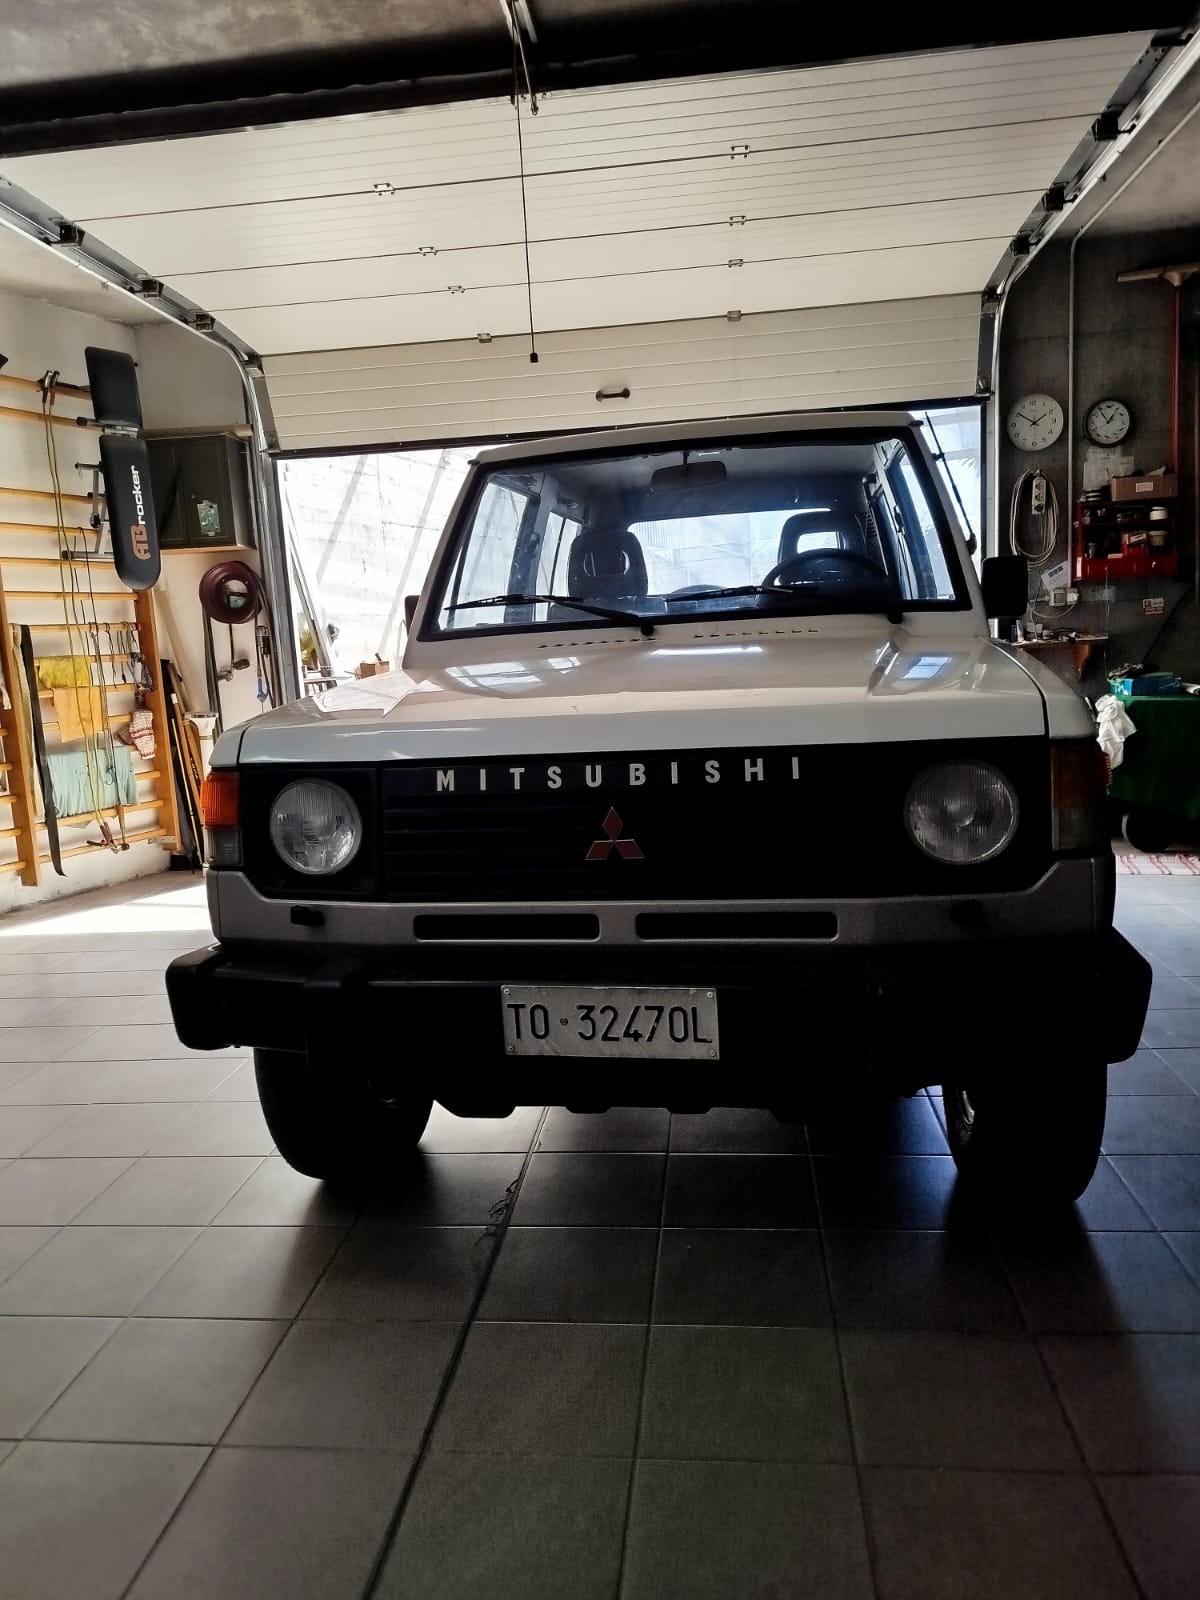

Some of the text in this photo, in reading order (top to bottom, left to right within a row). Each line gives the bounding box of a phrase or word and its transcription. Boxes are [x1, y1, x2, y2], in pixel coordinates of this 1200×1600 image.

[436, 756, 799, 791] MITSUBISHI
[507, 1003, 713, 1043] TO 32470L
